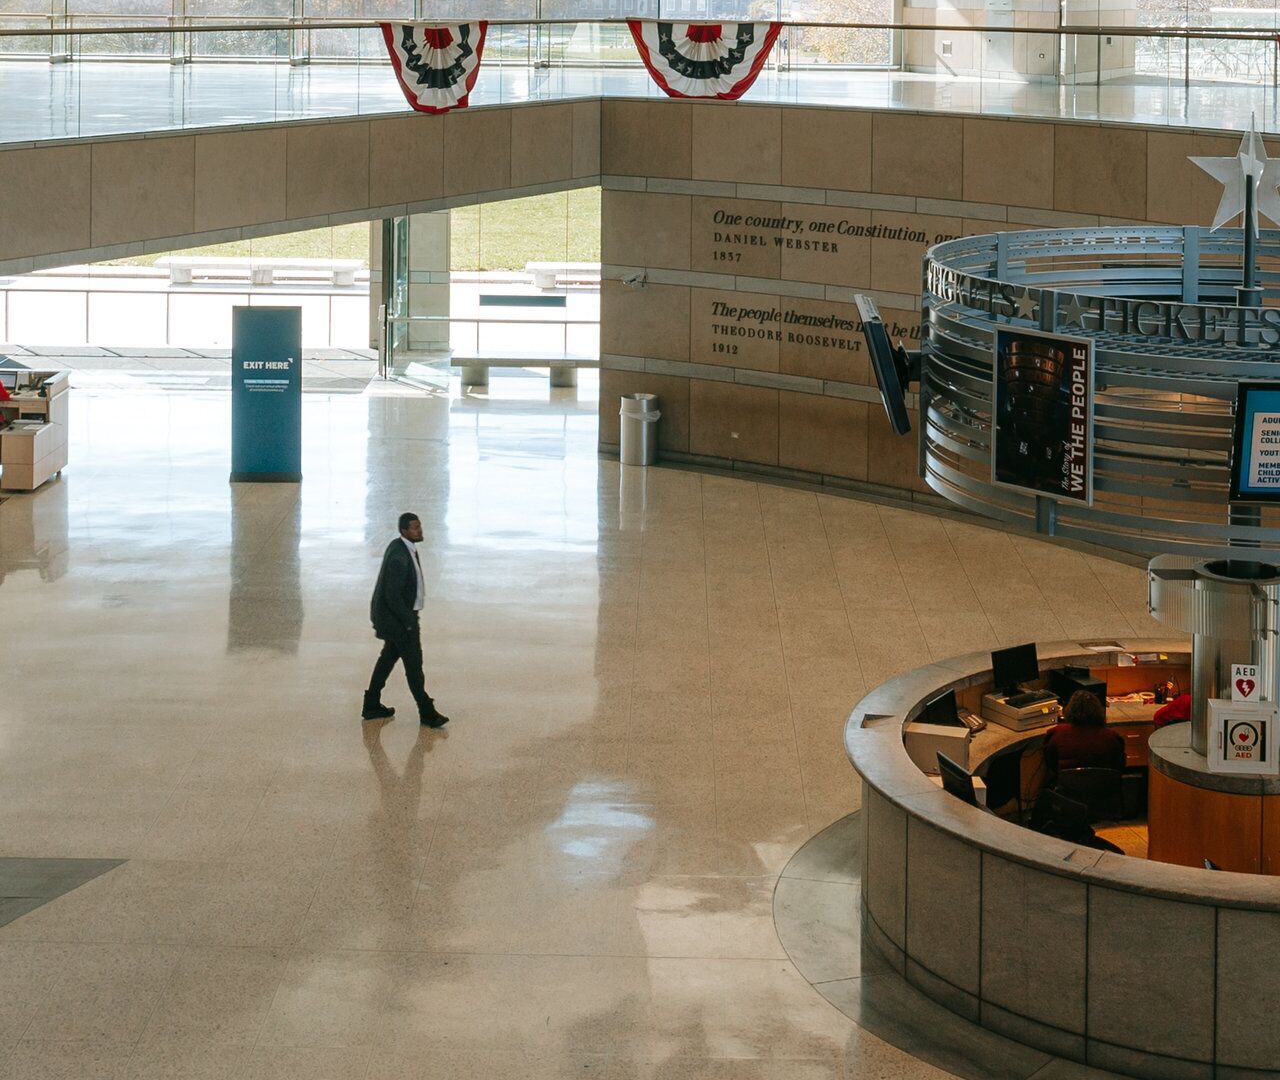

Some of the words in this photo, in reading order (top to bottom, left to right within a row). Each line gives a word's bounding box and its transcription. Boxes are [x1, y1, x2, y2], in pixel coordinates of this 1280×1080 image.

[713, 210, 742, 225] One
[745, 214, 804, 234] country,
[808, 221, 835, 234] one
[837, 220, 930, 245] Constitution,
[714, 232, 768, 246] DANIEL
[773, 237, 839, 253] WEBSTER
[711, 301, 737, 317] The
[737, 308, 782, 322] people
[783, 310, 854, 332] themselves
[891, 322, 908, 338] be
[712, 324, 782, 341] THEODORE
[787, 333, 862, 352] ROOSEVELT
[712, 342, 739, 355] 1912
[243, 361, 264, 370] EXIT
[265, 361, 290, 370] HERE
[1071, 348, 1086, 420] PEOPLE
[1062, 440, 1072, 451] of
[1071, 423, 1085, 459] THE
[1061, 452, 1073, 476] Story
[1070, 463, 1084, 492] WE
[1235, 667, 1256, 677] AED
